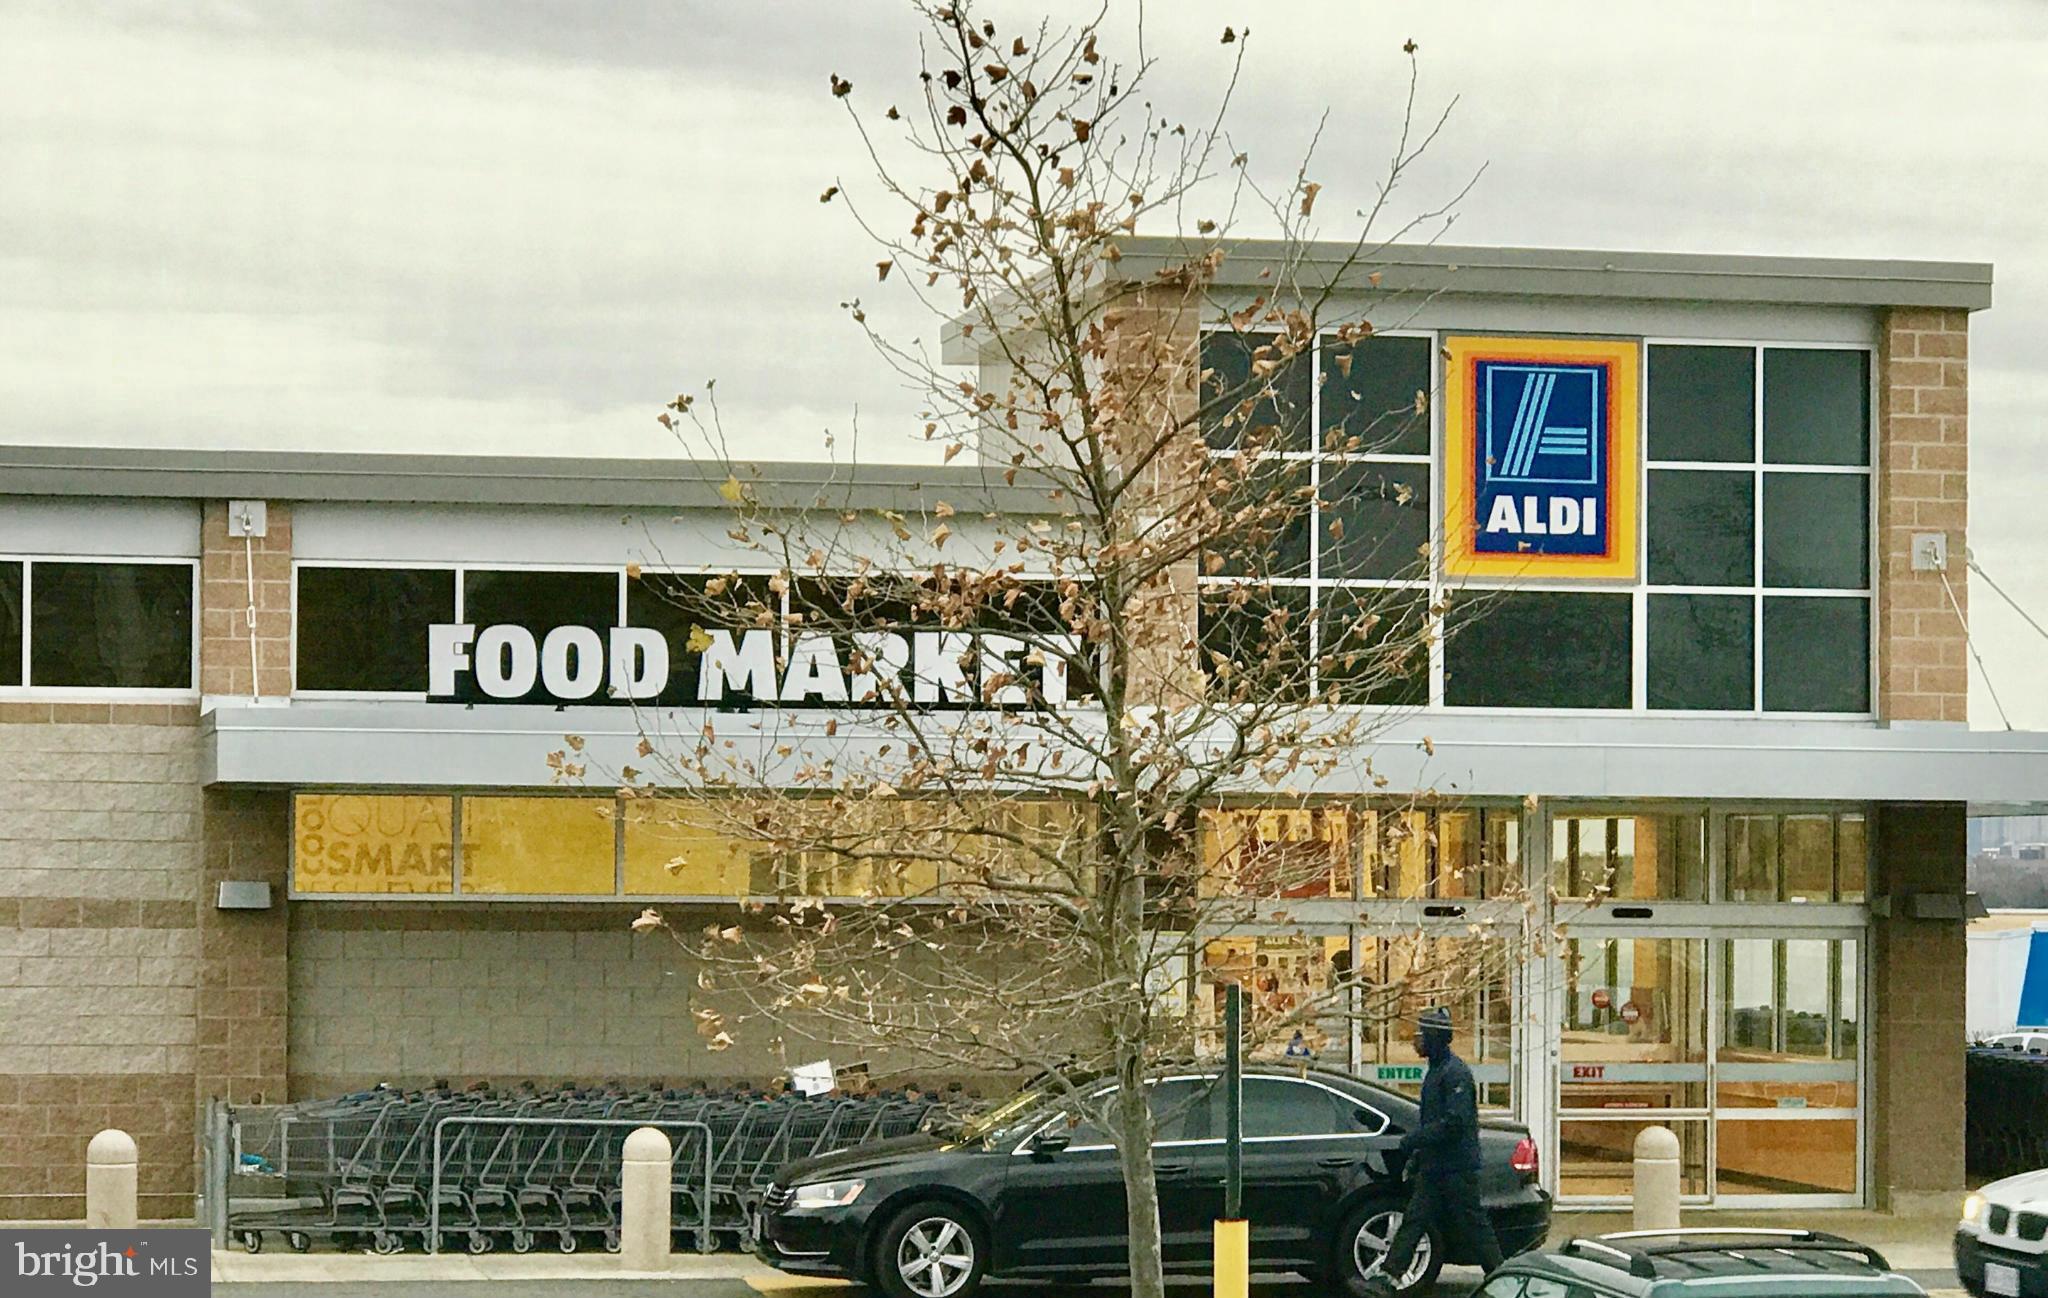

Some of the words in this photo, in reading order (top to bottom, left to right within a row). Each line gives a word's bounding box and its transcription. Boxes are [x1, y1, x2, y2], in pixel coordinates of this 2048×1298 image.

[1486, 495, 1597, 536] ALDI
[428, 623, 670, 700] FOOD
[697, 628, 1082, 704] MARKET
[326, 841, 481, 877] SMART
[1378, 1067, 1423, 1079] ENTER
[1573, 1066, 1605, 1078] EXIT
